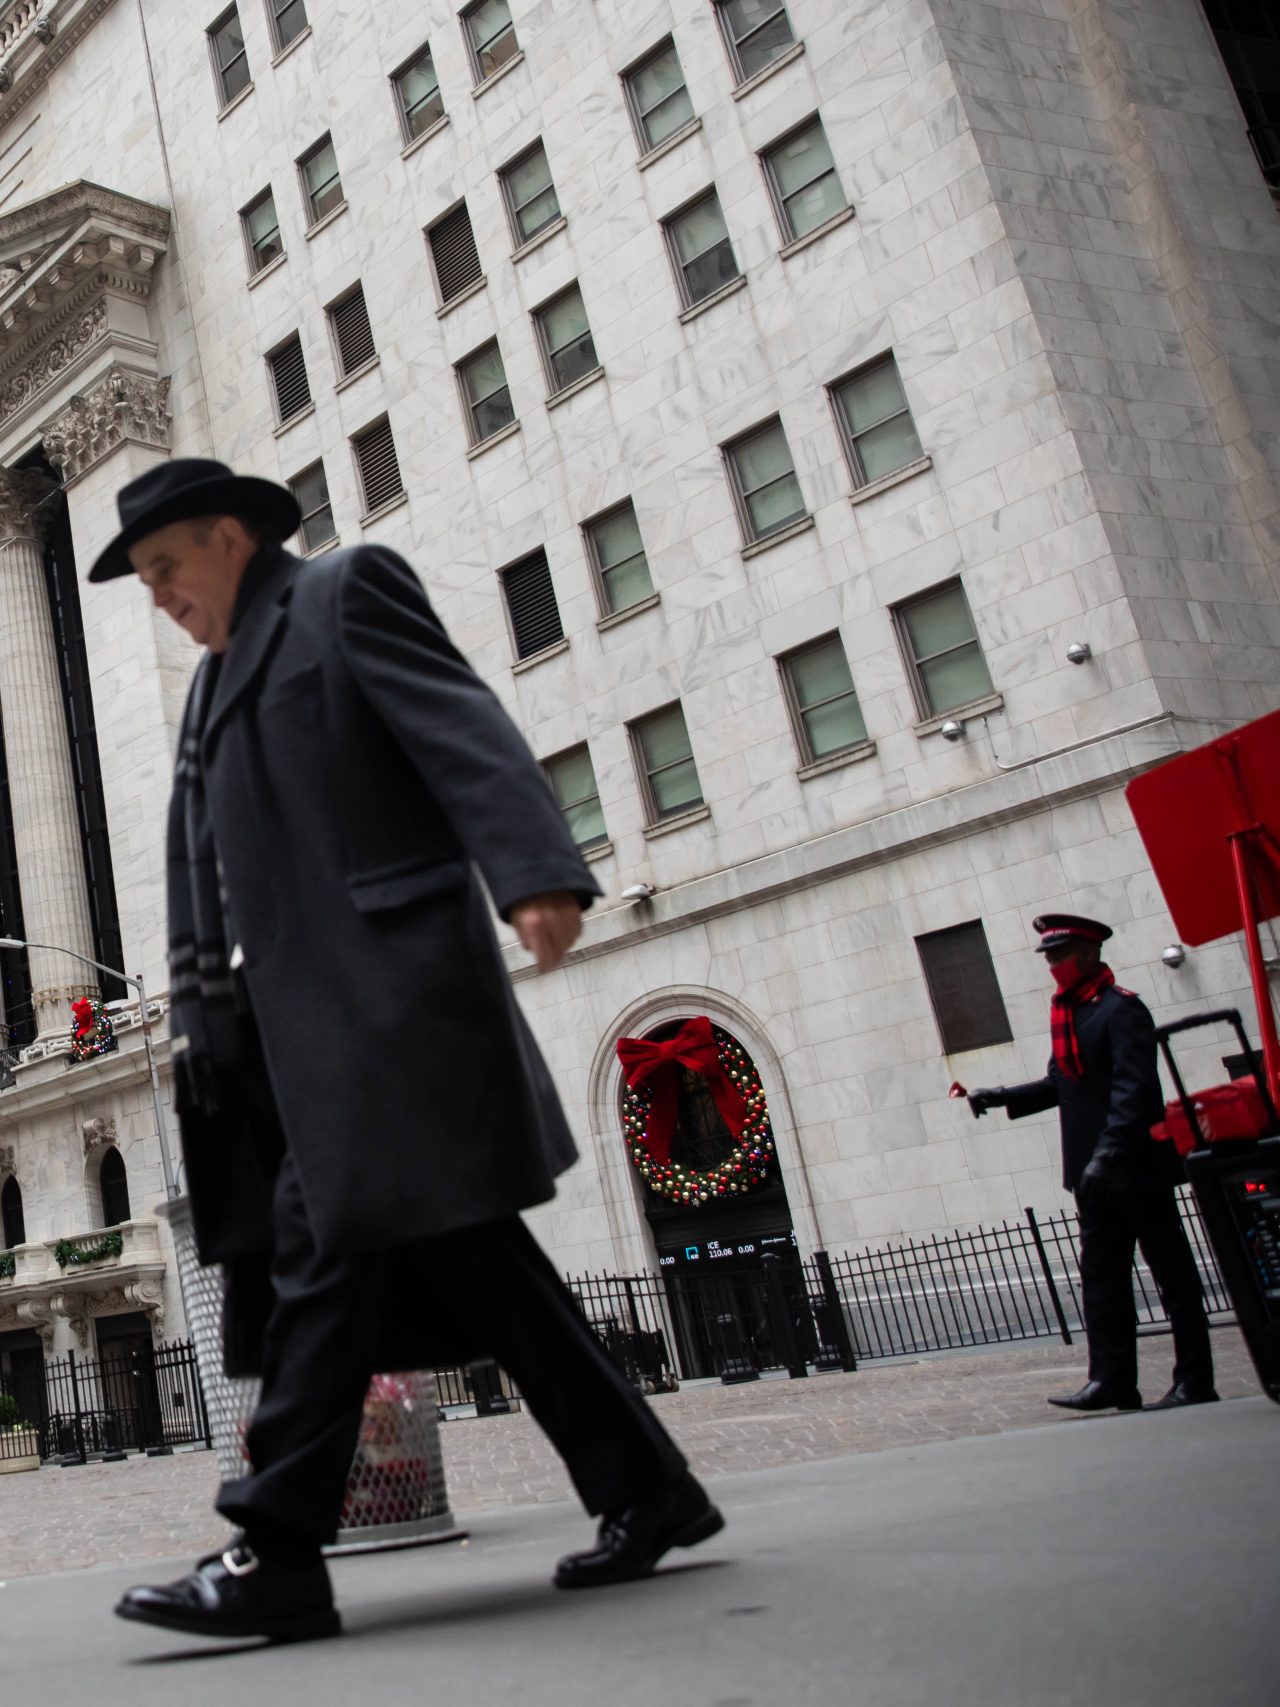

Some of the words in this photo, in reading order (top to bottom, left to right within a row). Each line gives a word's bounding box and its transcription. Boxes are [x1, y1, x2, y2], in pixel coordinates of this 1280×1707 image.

[707, 1241, 719, 1250] ICE
[709, 1247, 733, 1258] 110.06
[738, 1244, 754, 1254] 0.00
[660, 1256, 675, 1265] 0.00
